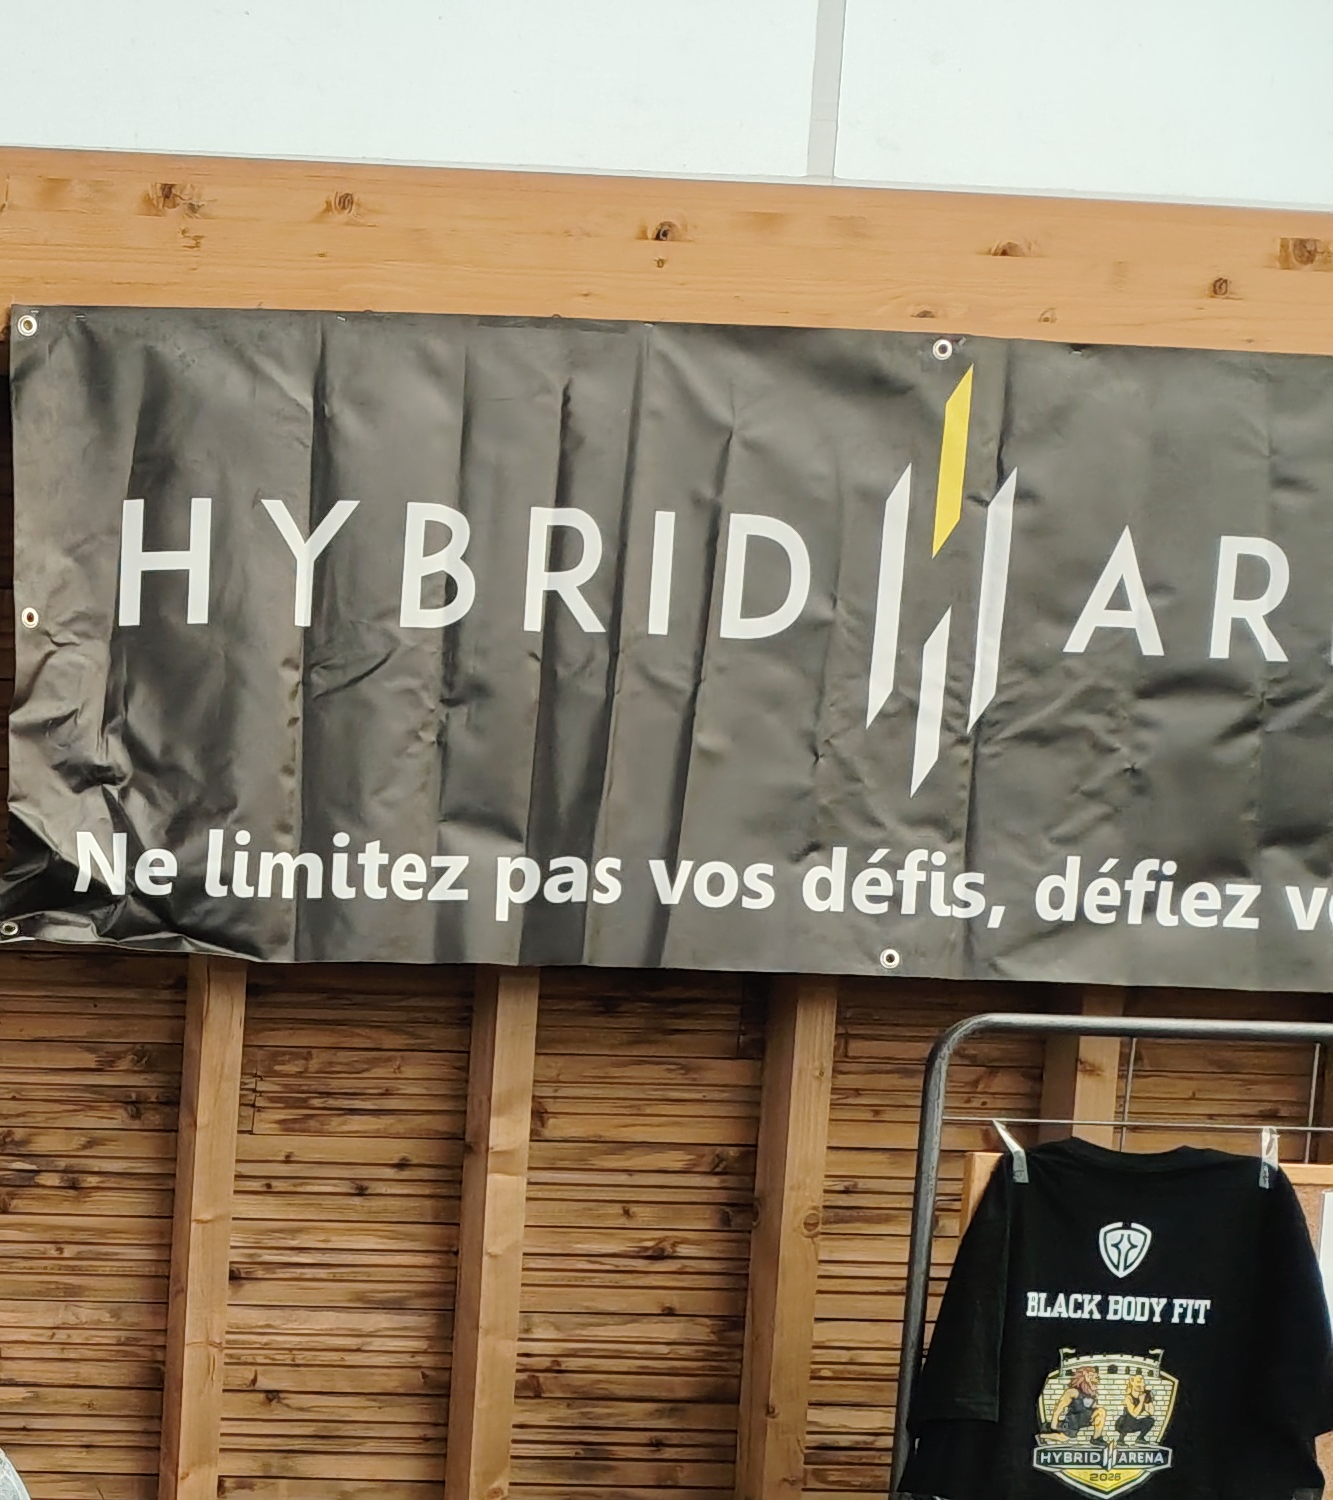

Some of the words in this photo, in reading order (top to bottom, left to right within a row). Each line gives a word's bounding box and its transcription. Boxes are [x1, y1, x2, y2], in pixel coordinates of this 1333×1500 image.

[117, 496, 812, 640] HYBRID
[1064, 525, 1333, 662] AR
[73, 830, 176, 898] Ne
[203, 828, 469, 903] limitez
[495, 849, 622, 936] pas
[650, 855, 774, 912] vos
[802, 846, 1004, 930] défis,
[1034, 854, 1256, 927] défiez
[1284, 880, 1333, 930] v
[1026, 1292, 1102, 1321] BLACK
[1107, 1295, 1166, 1323] BODY
[1171, 1299, 1210, 1325] FIT
[1040, 1450, 1100, 1464] HYBRID
[1118, 1452, 1165, 1464] ARENA
